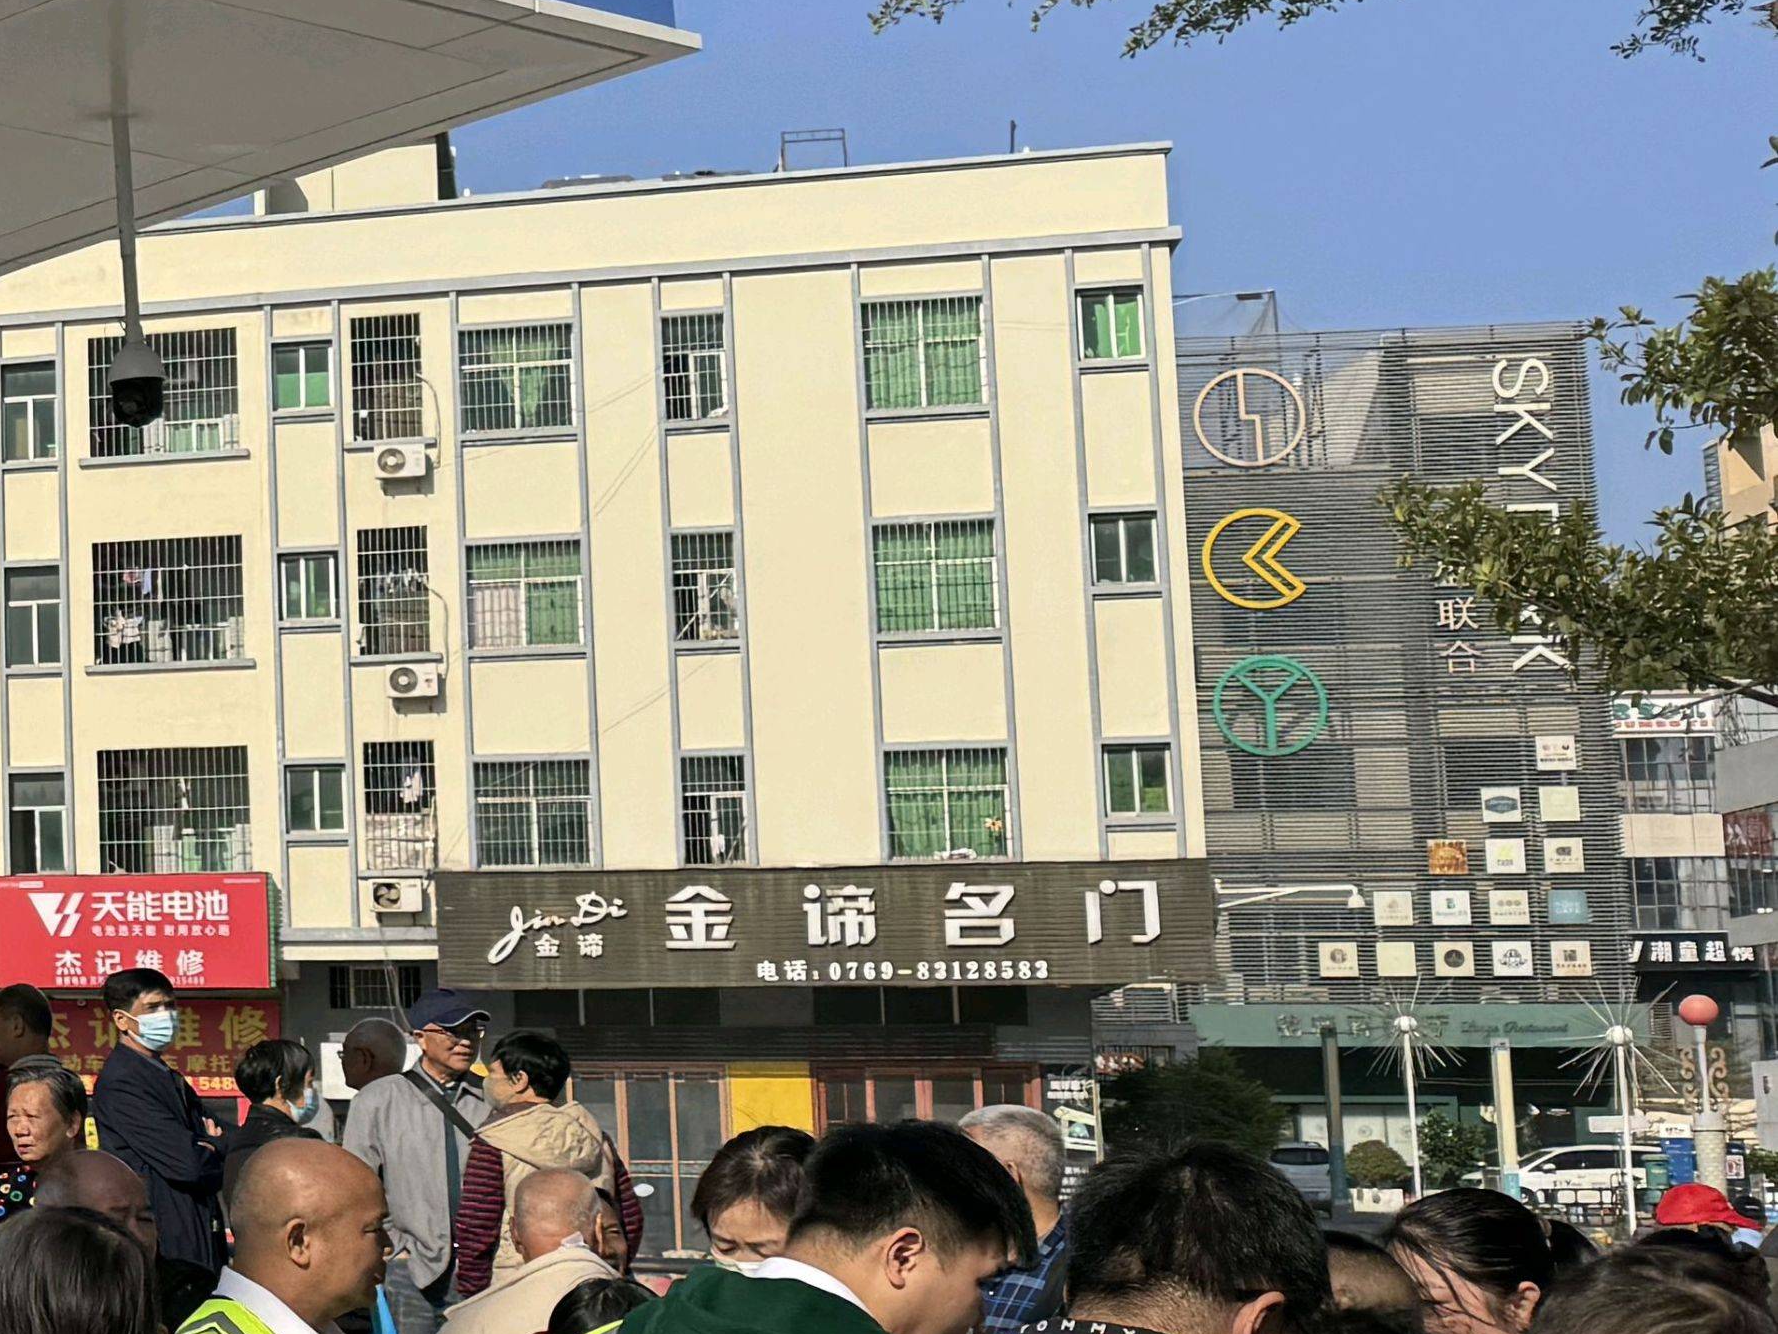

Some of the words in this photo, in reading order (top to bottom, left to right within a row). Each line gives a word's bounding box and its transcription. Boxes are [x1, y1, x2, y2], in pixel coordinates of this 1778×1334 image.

[91, 890, 230, 922] 天能电池
[665, 879, 1162, 950] 金谛名门
[534, 932, 605, 959] 金谛
